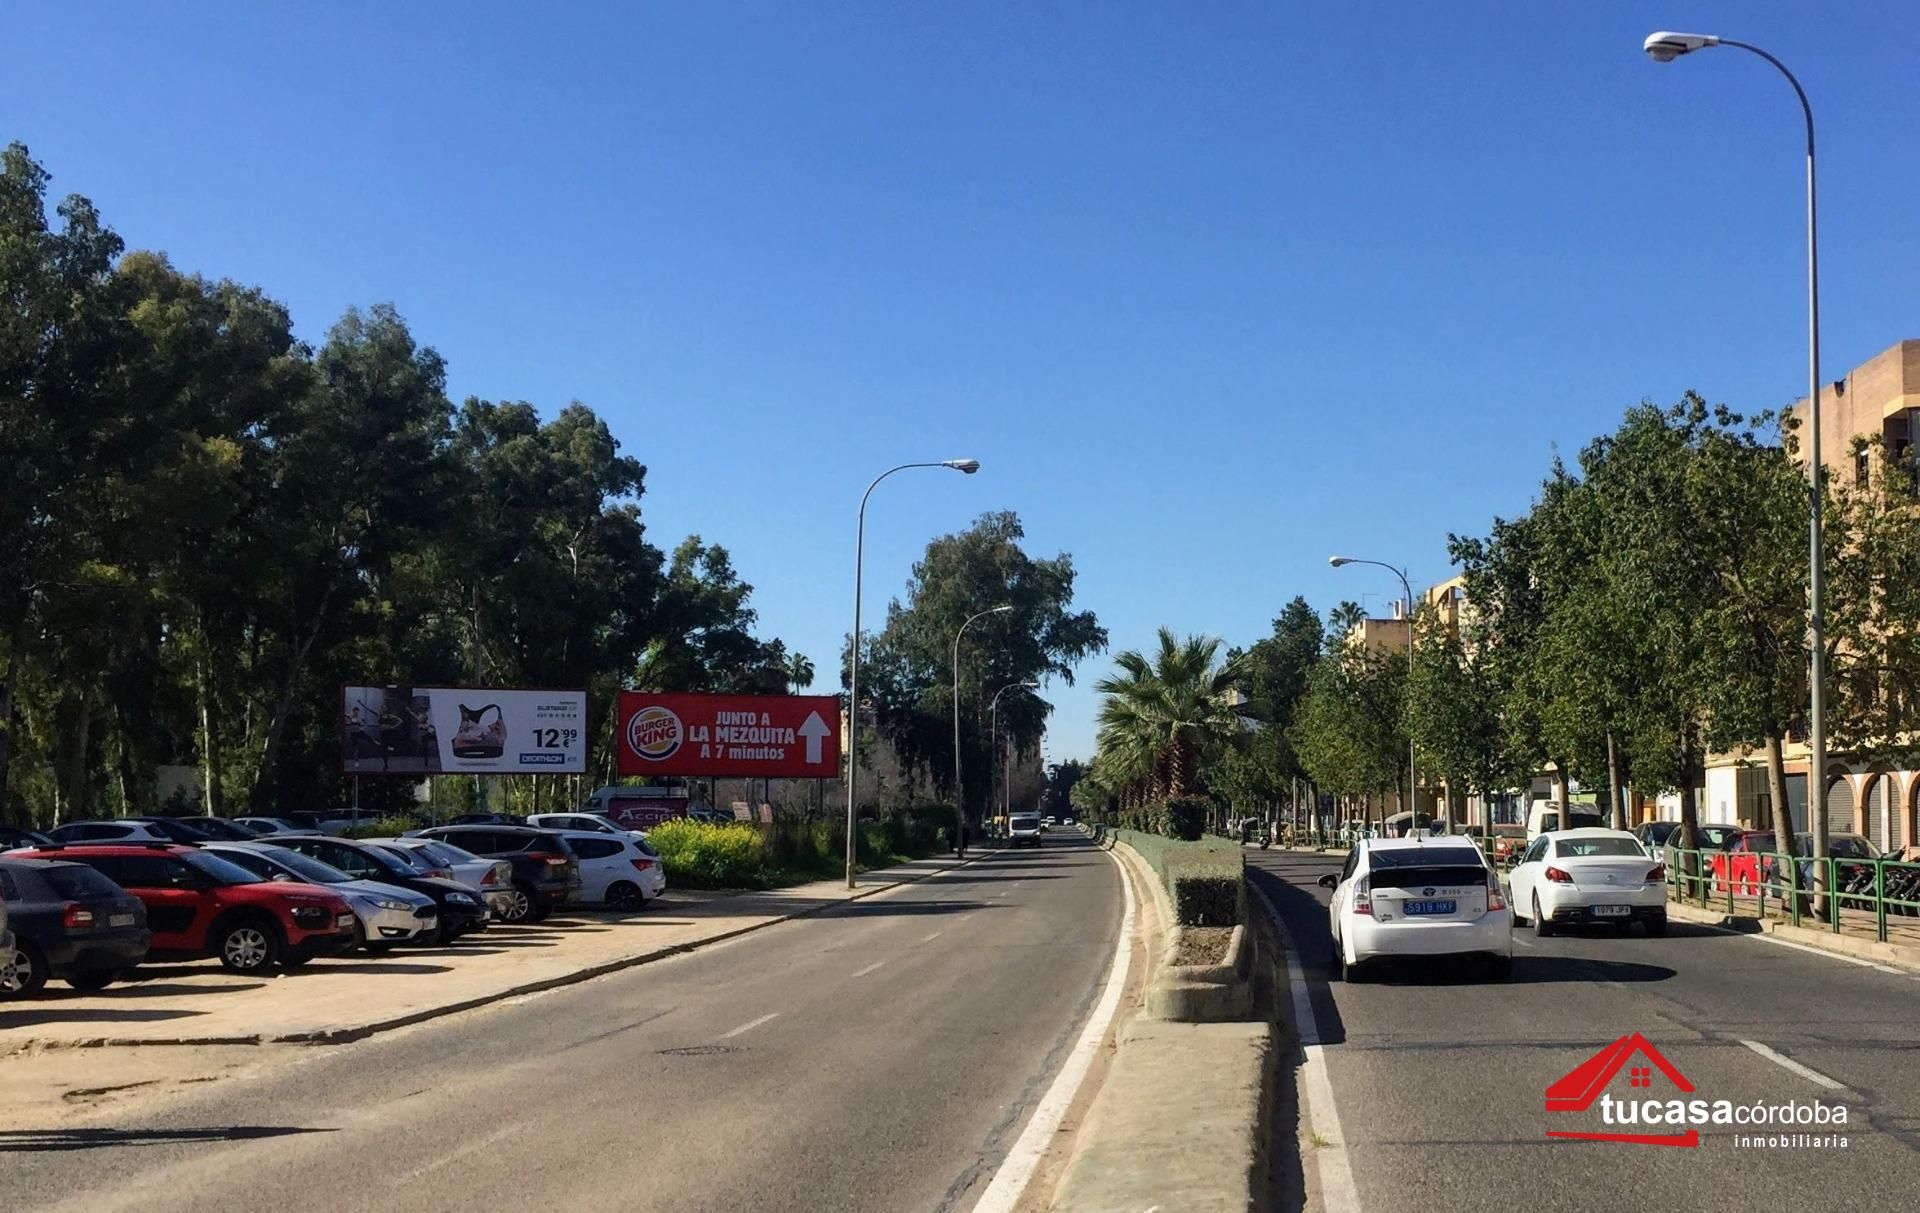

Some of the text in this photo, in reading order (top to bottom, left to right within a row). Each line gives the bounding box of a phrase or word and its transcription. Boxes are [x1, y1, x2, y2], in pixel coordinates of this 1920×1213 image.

[635, 718, 674, 735] BURGER
[716, 711, 770, 726] JUNTO A
[533, 729, 559, 748] 12
[636, 727, 677, 747] KING
[690, 725, 795, 744] LA MEZQUITA
[700, 745, 785, 760] A 7 minutos
